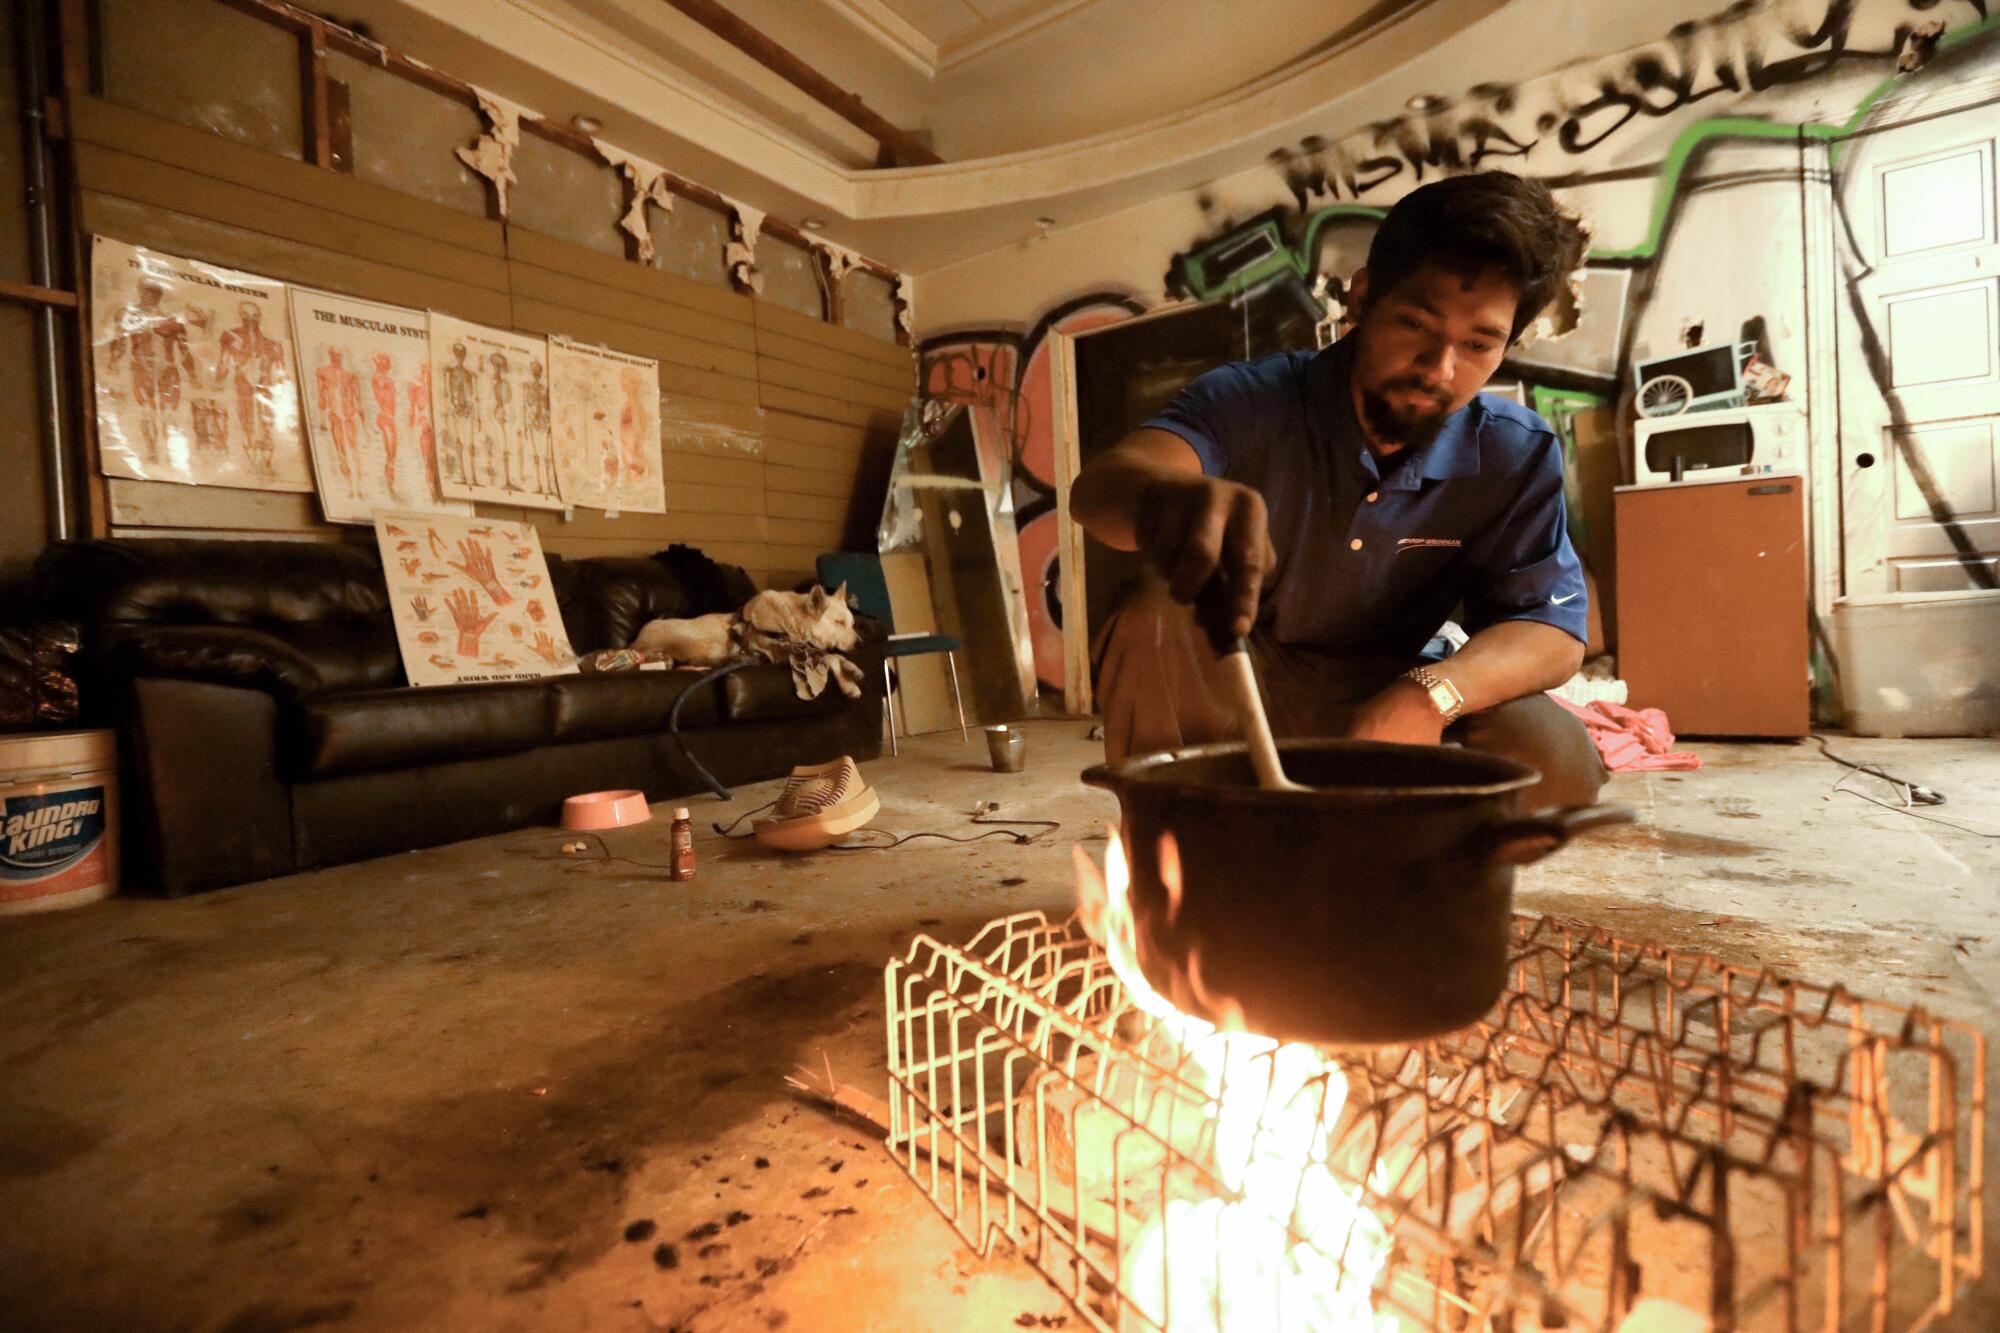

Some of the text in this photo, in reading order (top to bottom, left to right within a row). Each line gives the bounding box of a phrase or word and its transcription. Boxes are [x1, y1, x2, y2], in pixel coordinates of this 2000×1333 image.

[225, 284, 269, 299] SYSTEM
[313, 309, 337, 323] THE
[339, 315, 398, 335] MUSCULAR
[515, 672, 541, 680] HAND
